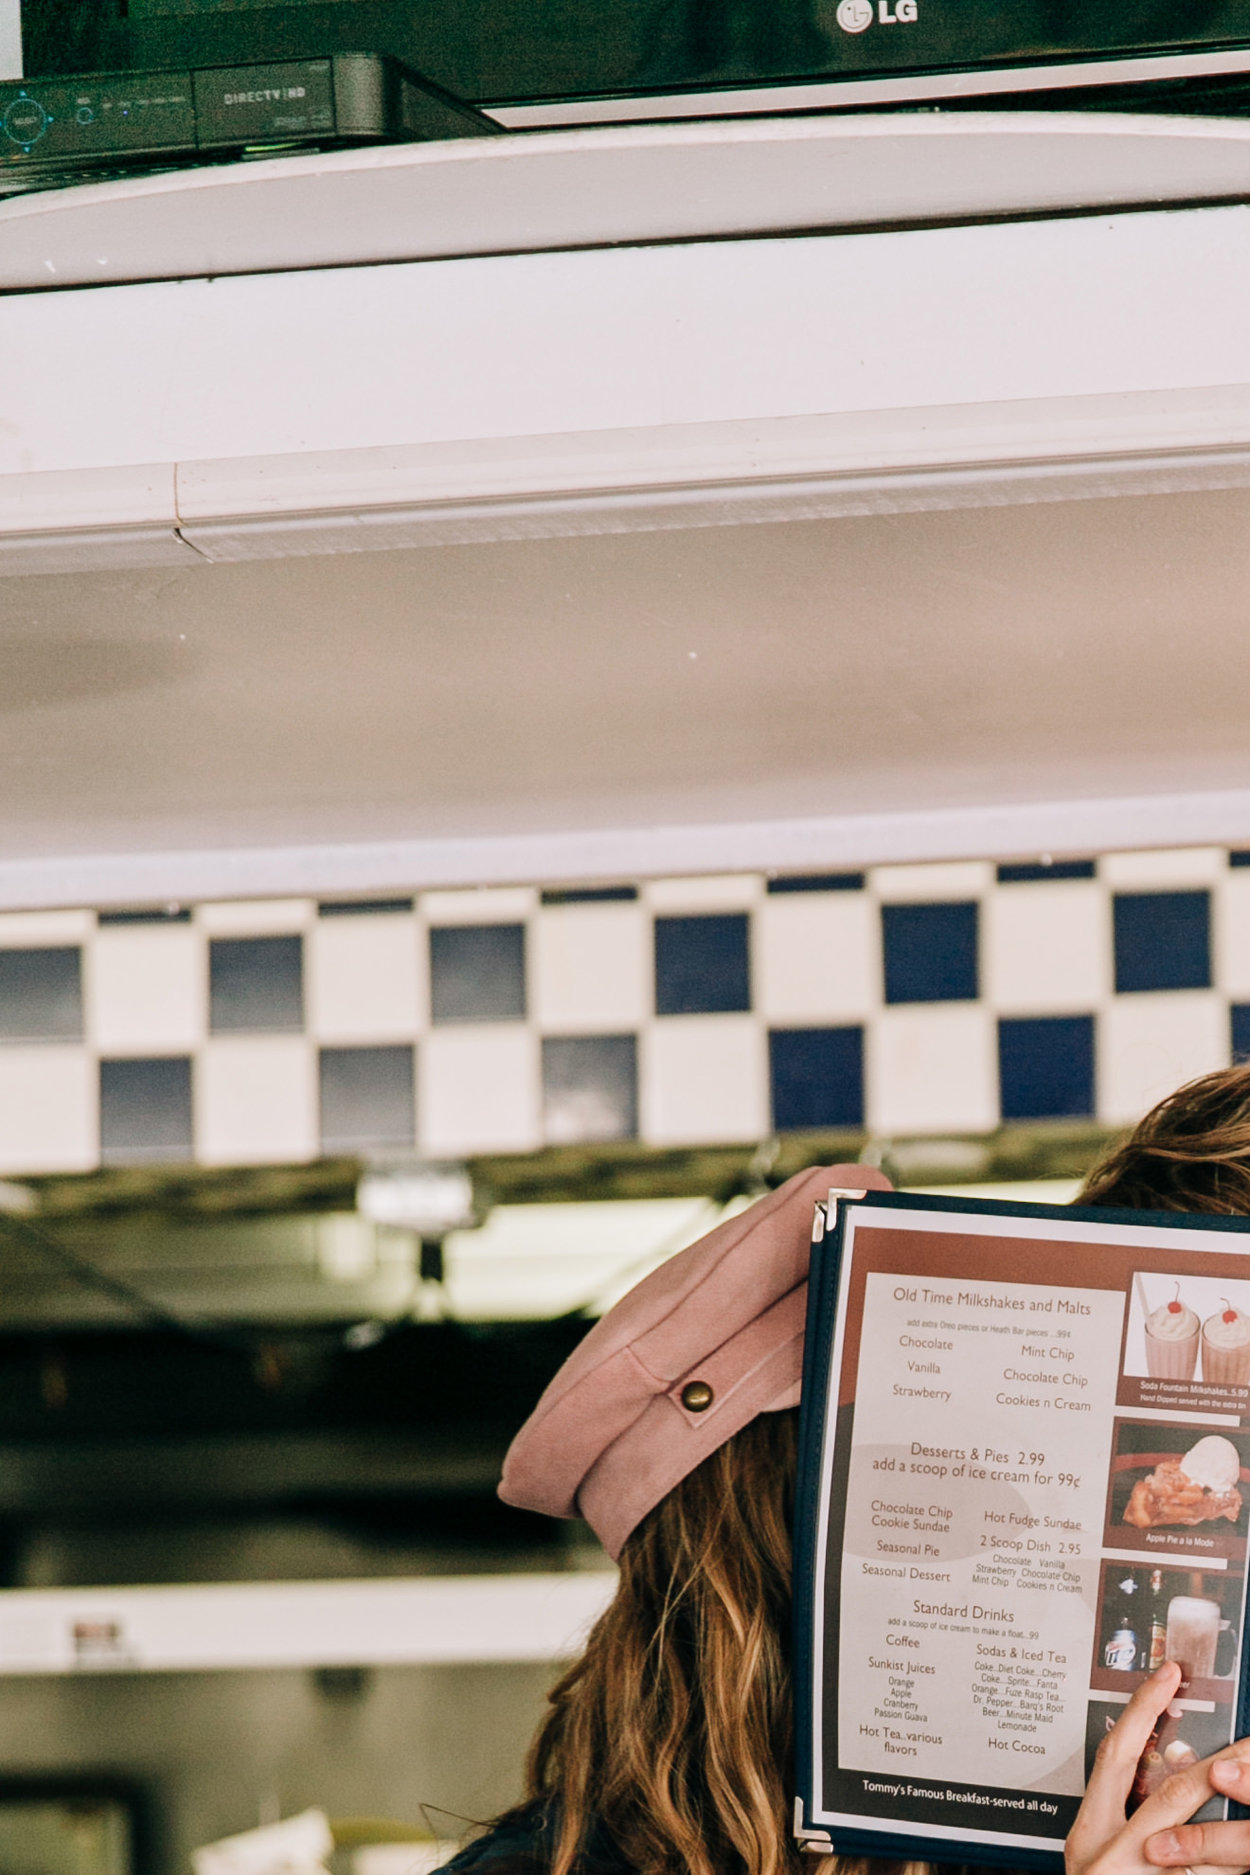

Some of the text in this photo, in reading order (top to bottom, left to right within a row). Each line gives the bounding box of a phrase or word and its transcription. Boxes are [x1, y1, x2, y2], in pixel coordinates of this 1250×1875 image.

[878, 0, 918, 24] LG
[893, 1288, 1091, 1315] Old Time Milkshakes and Malts
[907, 1319, 920, 1327] add
[940, 1321, 955, 1330] Oreo
[957, 1324, 979, 1333] pieces
[990, 1325, 1010, 1334] Heath
[1012, 1327, 1024, 1335] Bar
[1026, 1329, 1048, 1337] pieces
[899, 1335, 953, 1350] Chocolate
[1021, 1345, 1075, 1362] Mint Chip
[907, 1360, 941, 1374] Vanilla
[1003, 1368, 1088, 1389] Chocolate Chip
[1140, 1381, 1158, 1390] Soda
[1160, 1383, 1188, 1392] Fountain
[893, 1384, 951, 1403] Strawberry
[996, 1393, 1040, 1407] Cookies
[1054, 1398, 1091, 1411] Cream
[911, 1442, 1045, 1466] Desserts & Pies 2.99
[873, 1458, 895, 1471] add
[899, 1463, 906, 1472] a
[911, 1463, 948, 1479] scoop
[952, 1464, 964, 1477] of
[969, 1467, 986, 1479] ice
[991, 1472, 1030, 1483] cream
[1034, 1471, 1053, 1485] for
[872, 1500, 953, 1520] Chocolate Chip
[872, 1515, 950, 1533] Cookie Sundae
[984, 1511, 1082, 1530] Hot Fudge Sundae
[877, 1540, 940, 1557] Seasonal Pie
[981, 1535, 1081, 1555] 2 Scoop Dish 2.95
[1146, 1533, 1165, 1543] Apple
[1167, 1535, 1177, 1544] Pie
[1186, 1537, 1192, 1545] la
[1194, 1538, 1214, 1547] Mode
[993, 1554, 1066, 1569] Chocolate Vanilla
[862, 1563, 951, 1582] Seasonal Dessert
[976, 1564, 1080, 1583] Strawberry Chocolate Chip
[972, 1575, 989, 1585] Mint
[991, 1576, 1009, 1587] Chip
[1016, 1579, 1047, 1591] Cookies
[1057, 1583, 1082, 1593] Cream
[913, 1600, 1014, 1623] Standard Drinks
[888, 1618, 900, 1626] add
[909, 1620, 929, 1630] scoop
[930, 1621, 937, 1629] of
[939, 1622, 948, 1631] ice
[950, 1624, 971, 1633] cream
[973, 1626, 979, 1634] to
[981, 1627, 999, 1636] make
[886, 1634, 920, 1649] Coffee
[977, 1643, 1067, 1664] Sodas & Iced Tea
[868, 1656, 936, 1675] Sunkist Juices
[888, 1676, 915, 1688] Orange
[891, 1688, 912, 1698] Apple
[1025, 1689, 1044, 1700] Rasp
[883, 1698, 919, 1712] Cranberry
[1046, 1703, 1064, 1713] Root
[874, 1707, 928, 1722] Passion Guava
[1035, 1713, 1053, 1723] Maid
[860, 1724, 879, 1737] Hot
[997, 1720, 1037, 1732] Lemonade
[885, 1741, 917, 1756] flavors
[988, 1737, 1046, 1754] Hot Cocoa
[863, 1780, 1058, 1815] Tommy's Famous Breakfast-served all day
